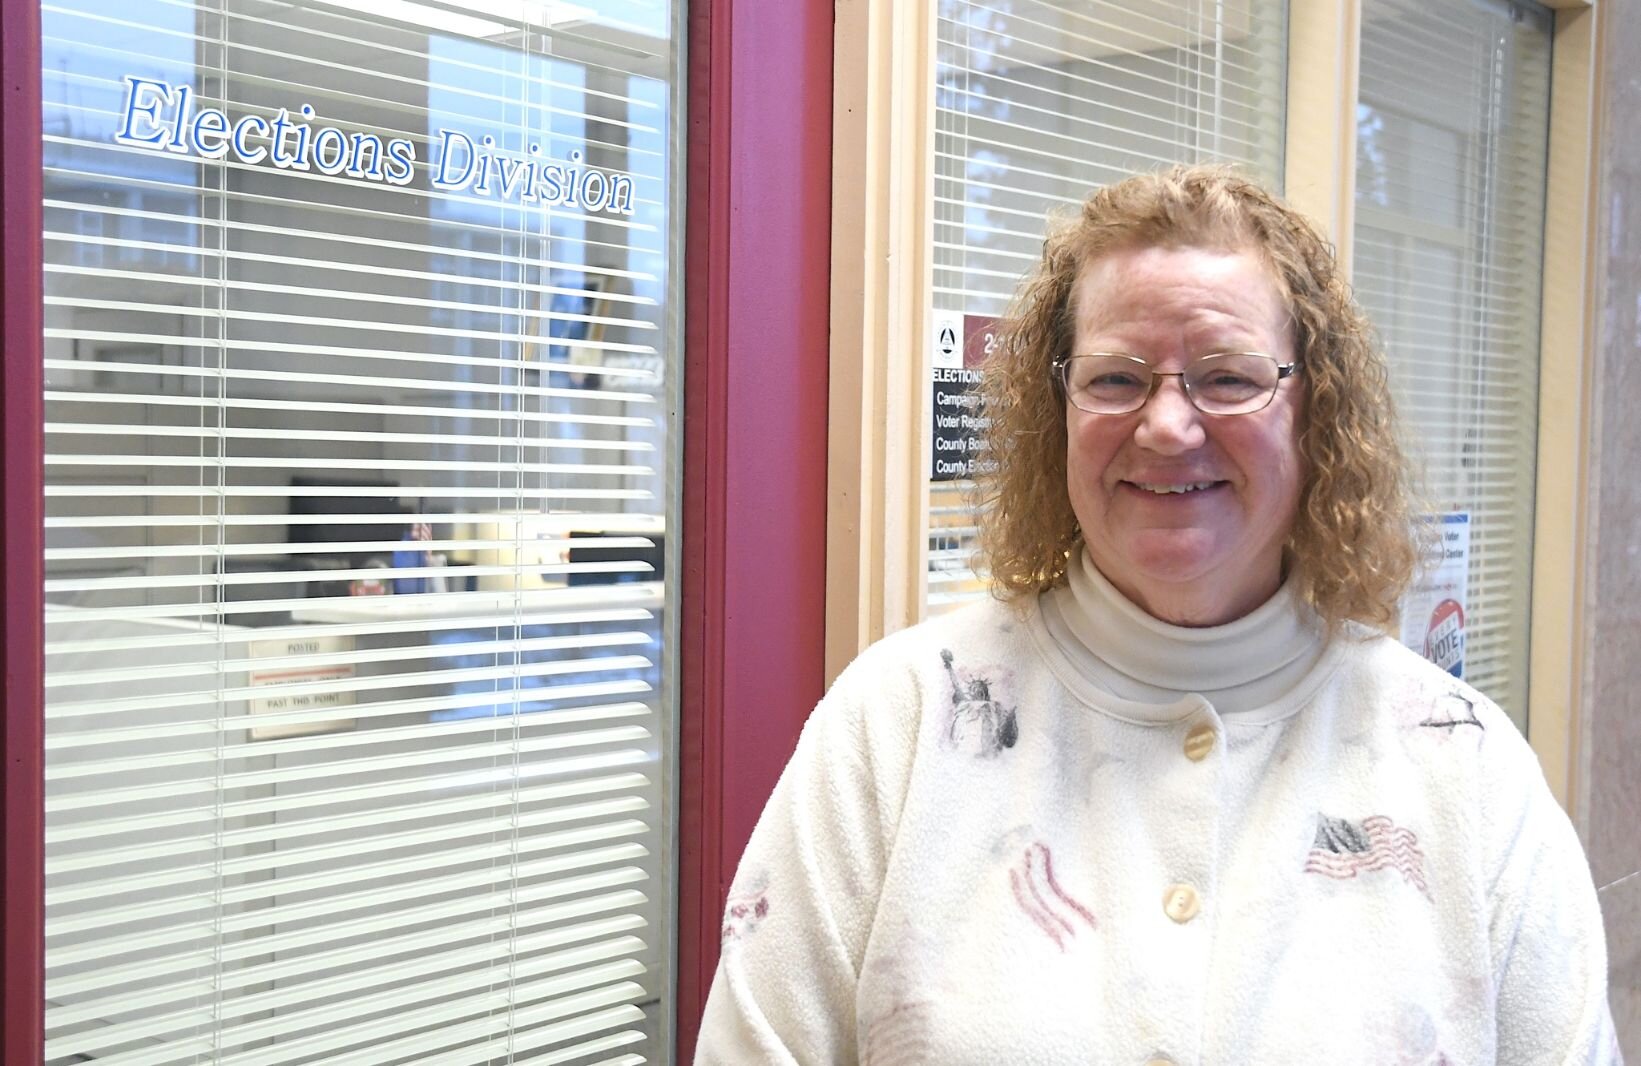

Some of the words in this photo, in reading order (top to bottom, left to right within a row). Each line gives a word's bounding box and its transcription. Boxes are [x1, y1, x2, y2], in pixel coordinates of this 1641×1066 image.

[116, 75, 417, 184] Elections
[432, 128, 635, 215] Division
[933, 369, 985, 382] ELECTIONS
[936, 414, 960, 428] Voter
[936, 437, 966, 453] County
[936, 459, 966, 476] County
[1431, 628, 1458, 664] VOTE
[267, 699, 288, 708] PAST
[293, 697, 311, 705] THIS
[315, 694, 340, 703] POINT
